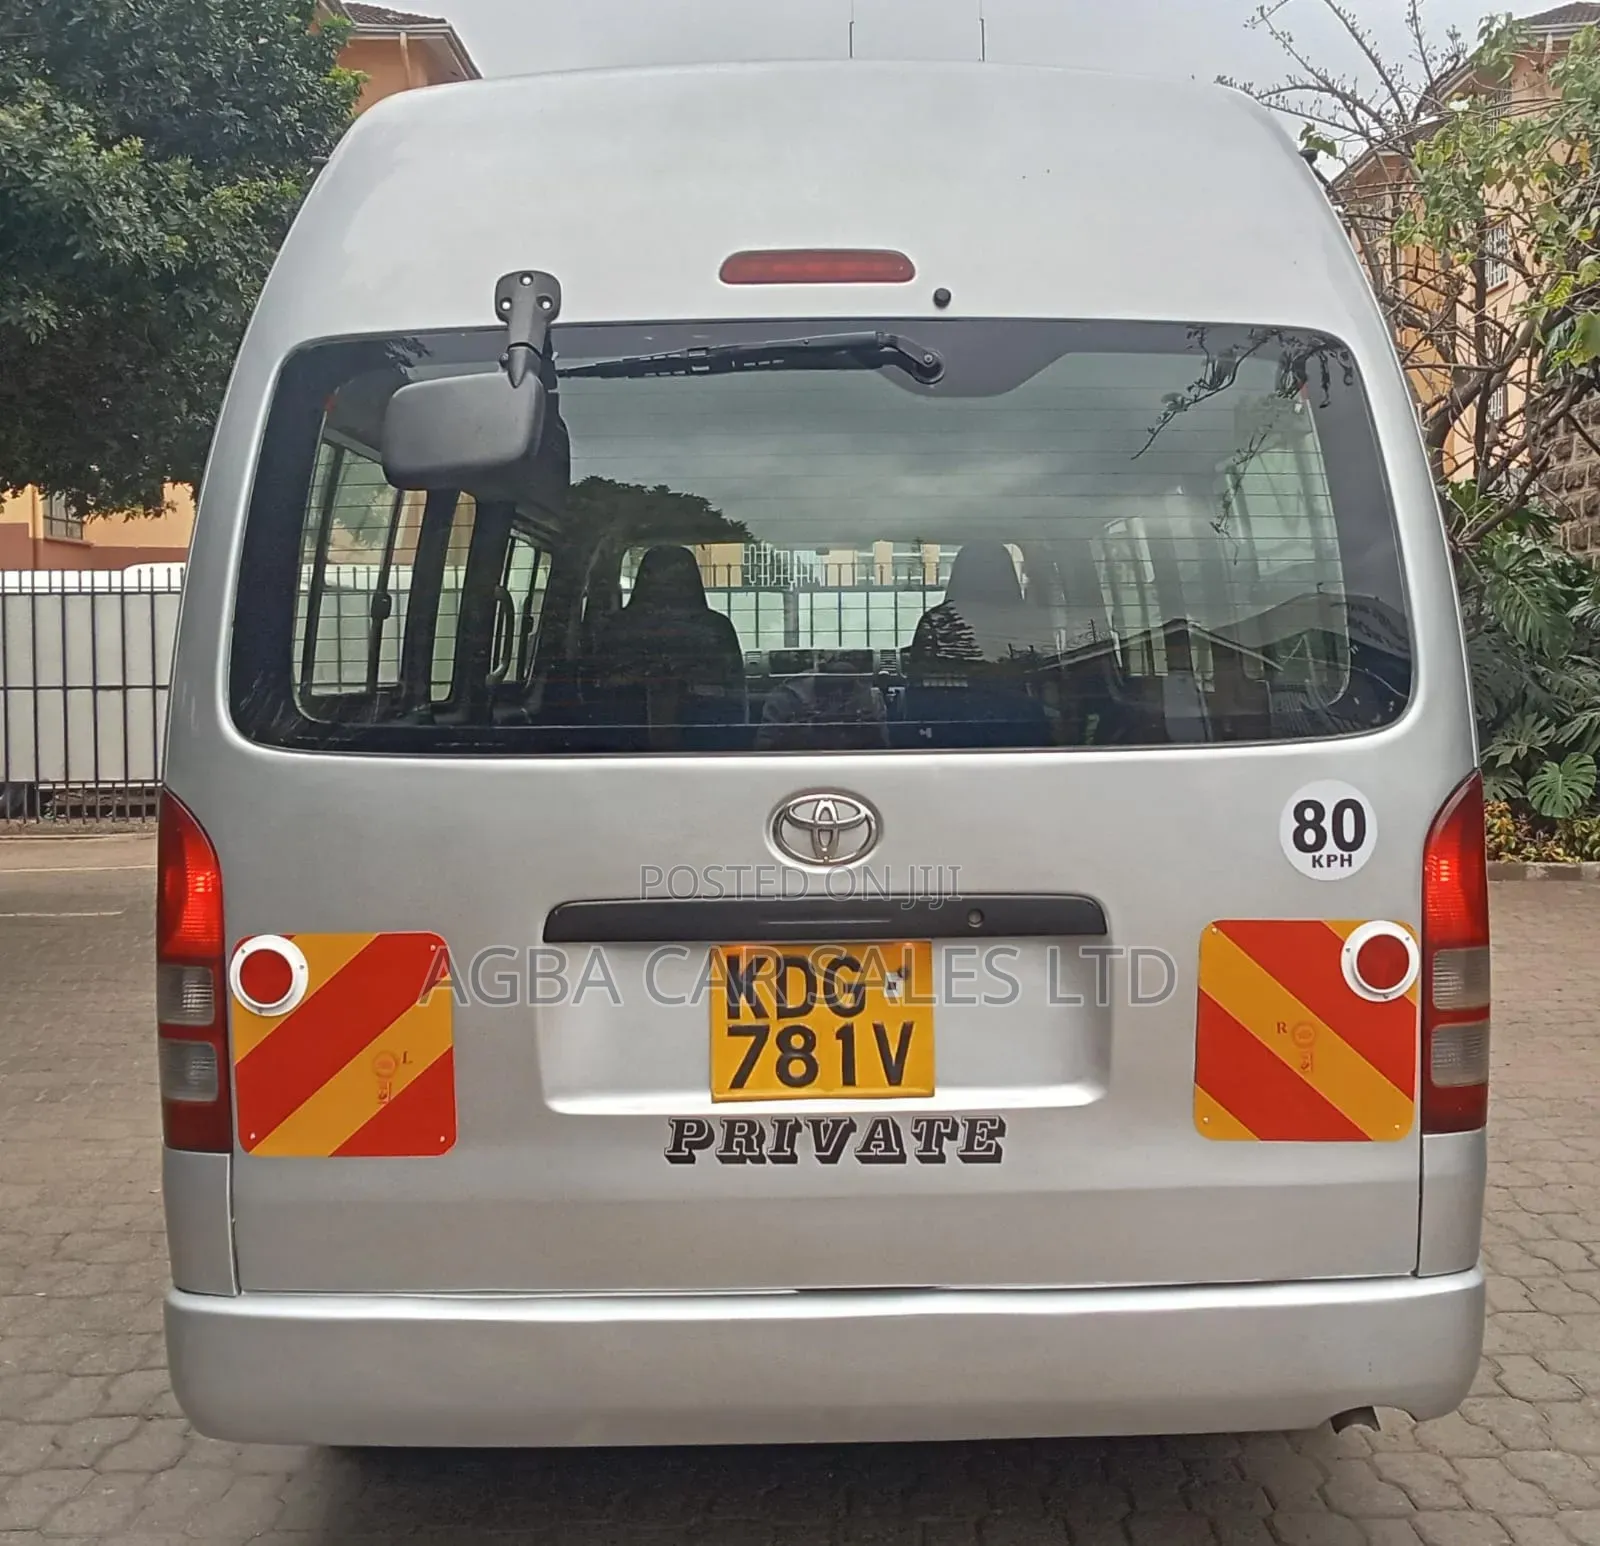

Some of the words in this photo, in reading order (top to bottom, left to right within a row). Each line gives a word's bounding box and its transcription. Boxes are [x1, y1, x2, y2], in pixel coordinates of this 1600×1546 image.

[1292, 798, 1367, 853] 80
[1311, 854, 1353, 869] KPH
[725, 956, 866, 1021] KDG
[725, 1021, 915, 1090] 781V
[664, 1116, 1007, 1165] PRIVATE
